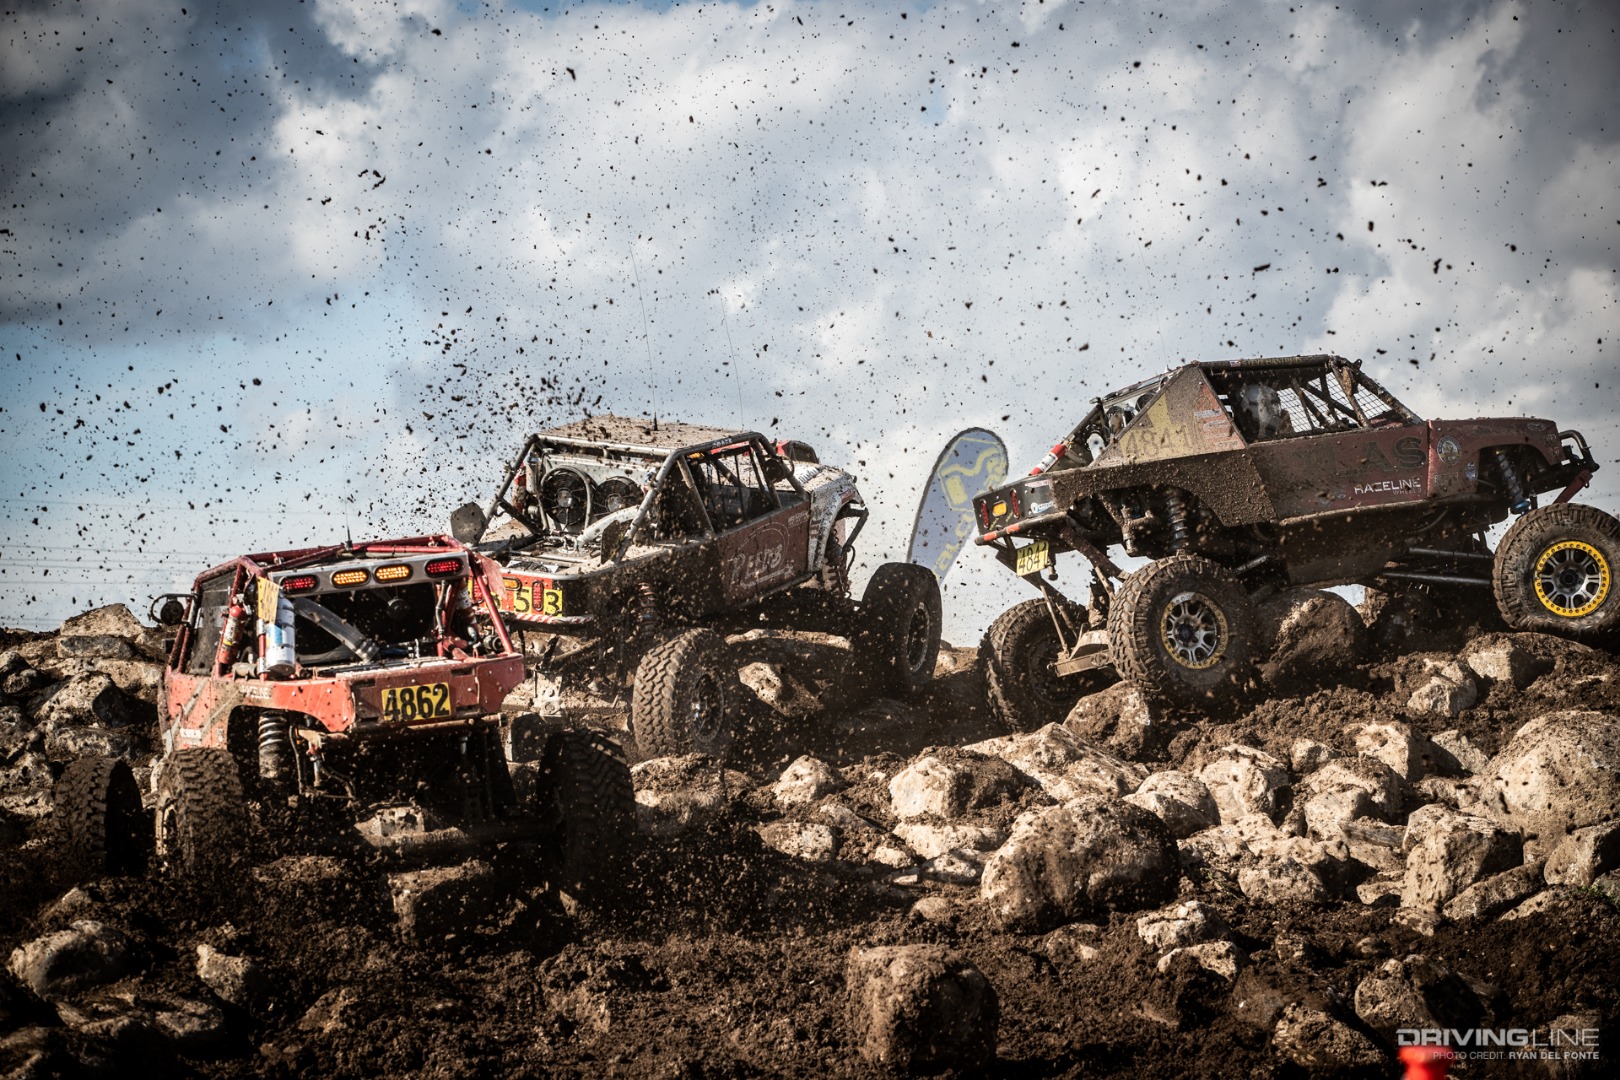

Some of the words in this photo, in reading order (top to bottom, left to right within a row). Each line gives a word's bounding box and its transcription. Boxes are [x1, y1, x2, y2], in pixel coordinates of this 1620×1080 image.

[1126, 425, 1193, 457] 4841
[1018, 542, 1047, 573] 4841
[384, 683, 450, 720] 4862
